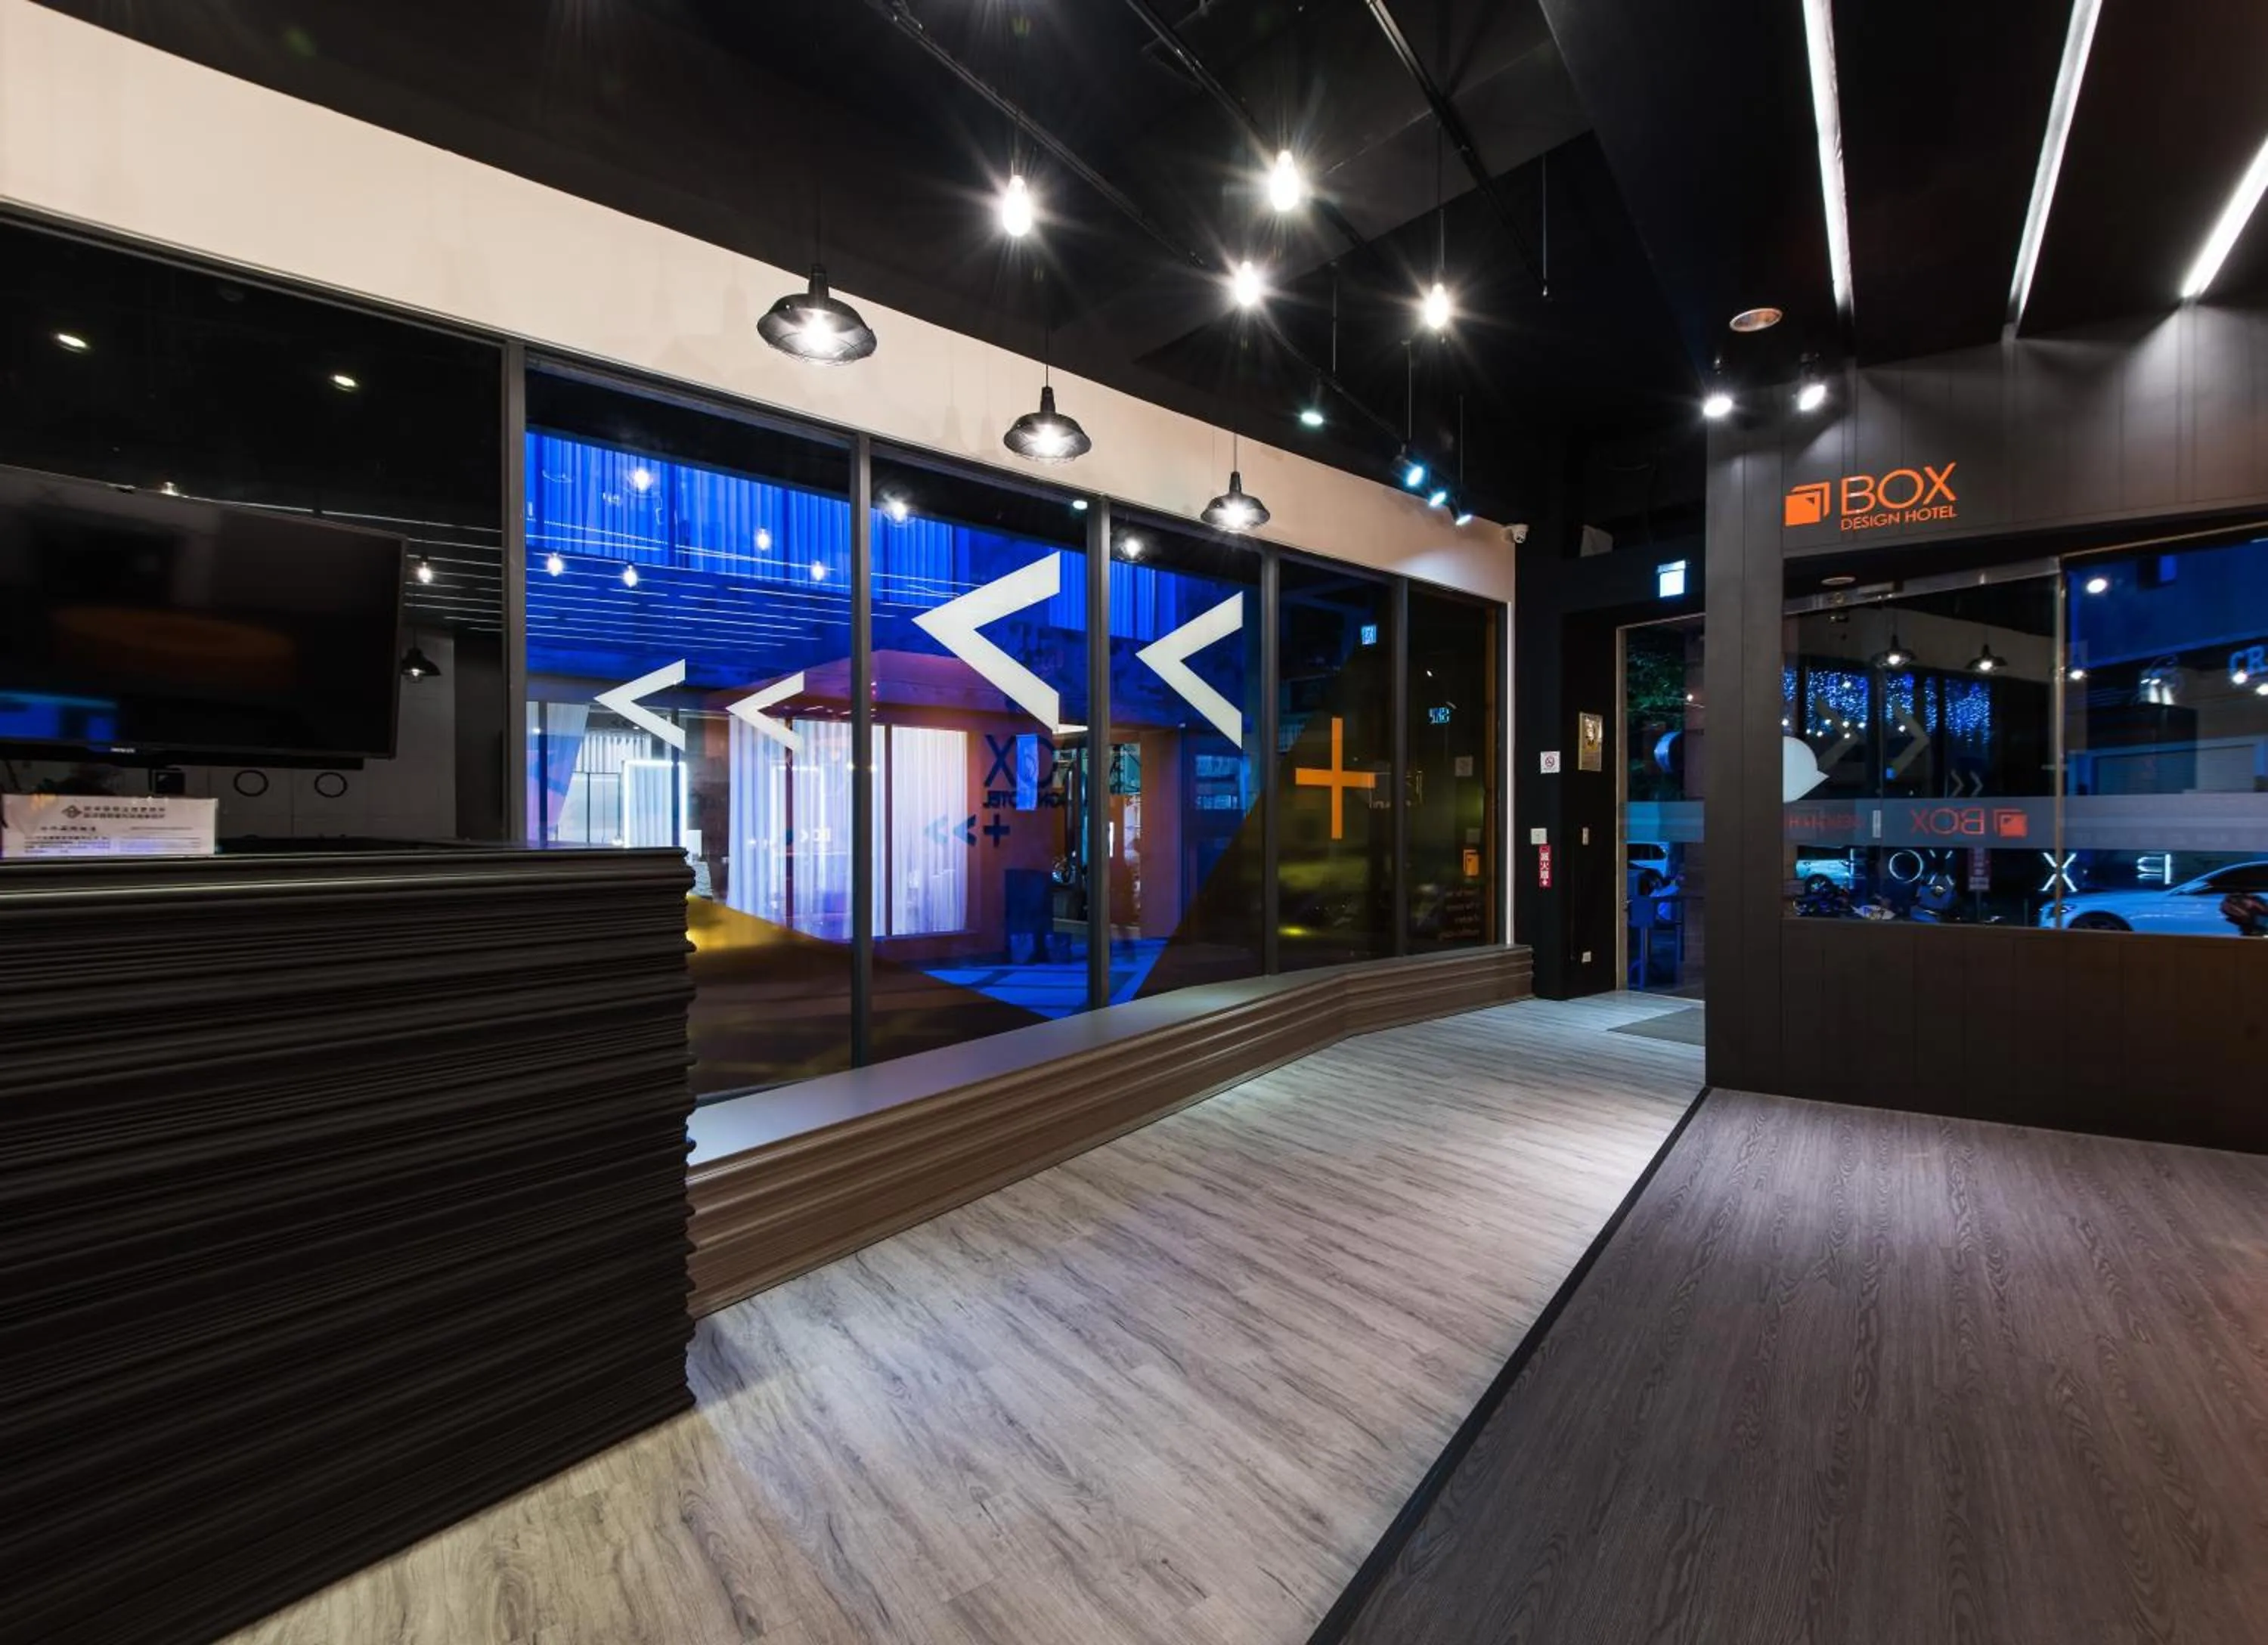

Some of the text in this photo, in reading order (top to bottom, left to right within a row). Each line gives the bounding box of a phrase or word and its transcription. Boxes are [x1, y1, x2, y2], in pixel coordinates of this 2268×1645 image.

[1840, 461, 1957, 516] BOX
[1840, 505, 1958, 530] DESIGN HOTEL
